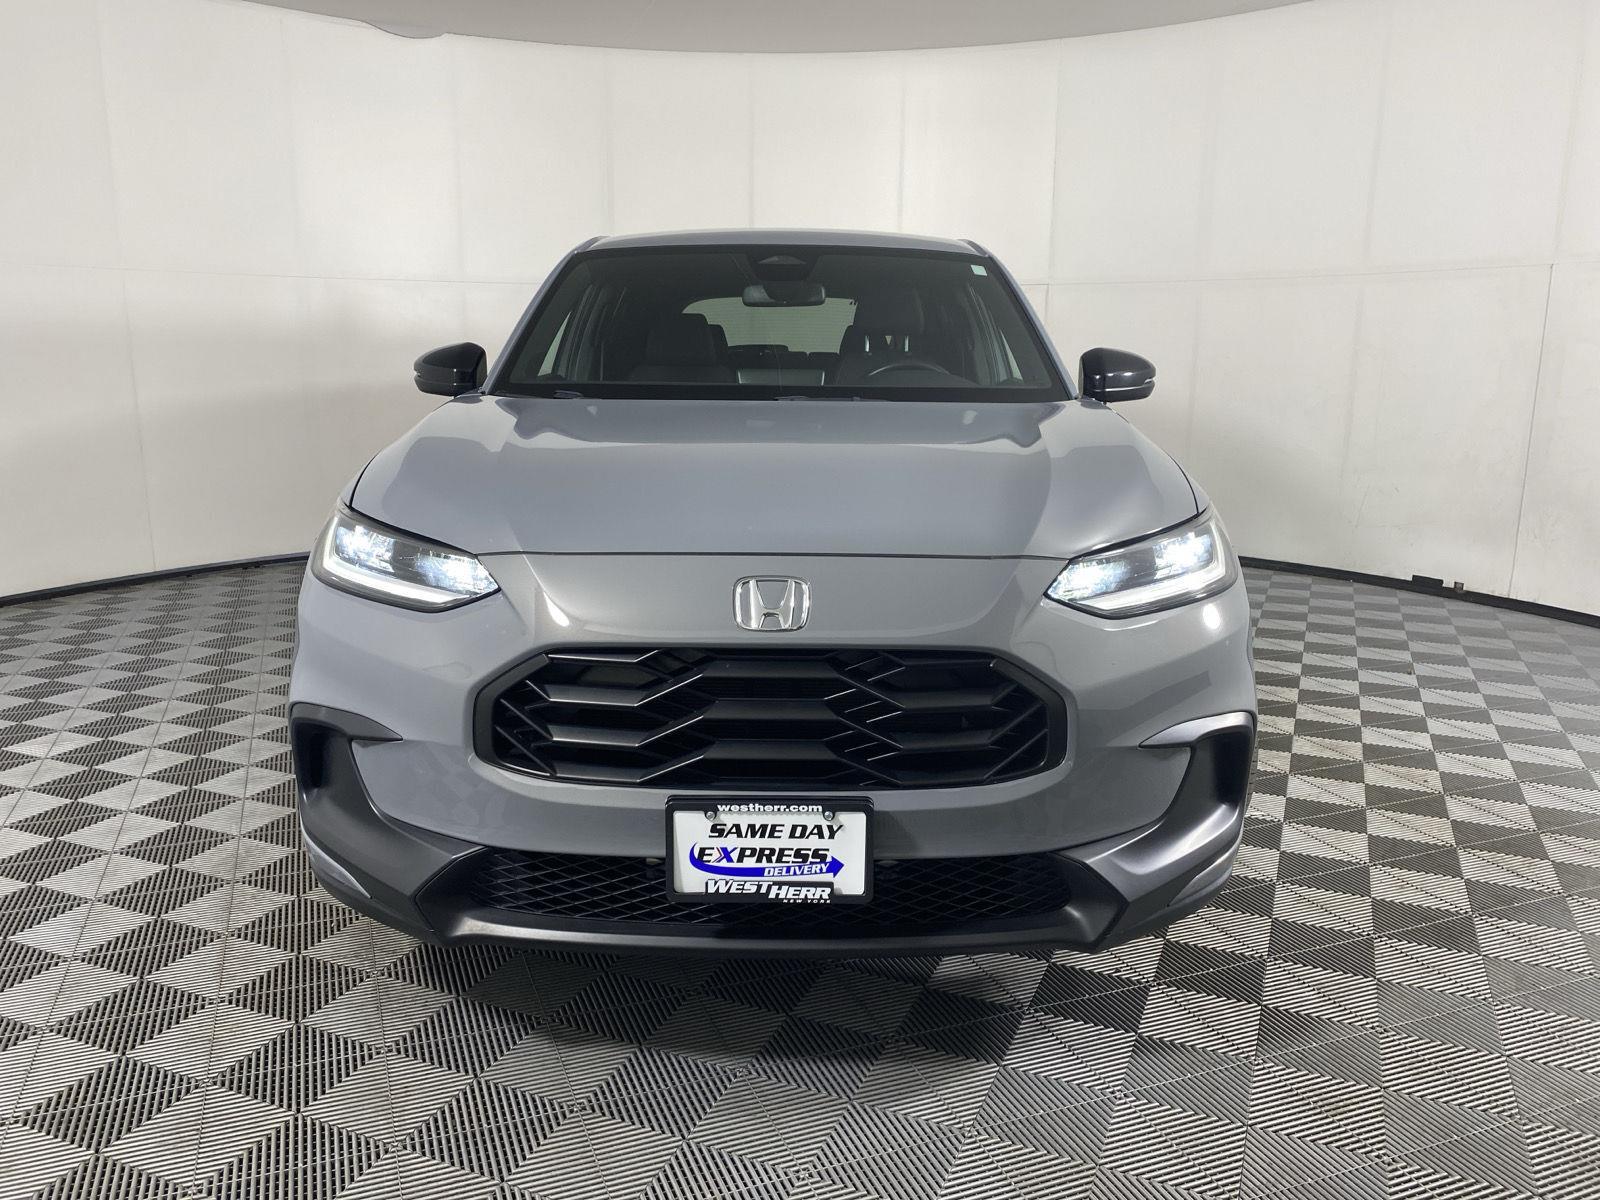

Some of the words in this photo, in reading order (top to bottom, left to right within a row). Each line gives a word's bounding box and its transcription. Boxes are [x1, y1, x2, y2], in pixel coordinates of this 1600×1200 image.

[717, 803, 823, 812] westherr.com
[708, 823, 785, 839] SAME
[789, 824, 844, 840] DAY
[696, 846, 830, 864] EXPRESS
[763, 863, 830, 877] DELIVERY
